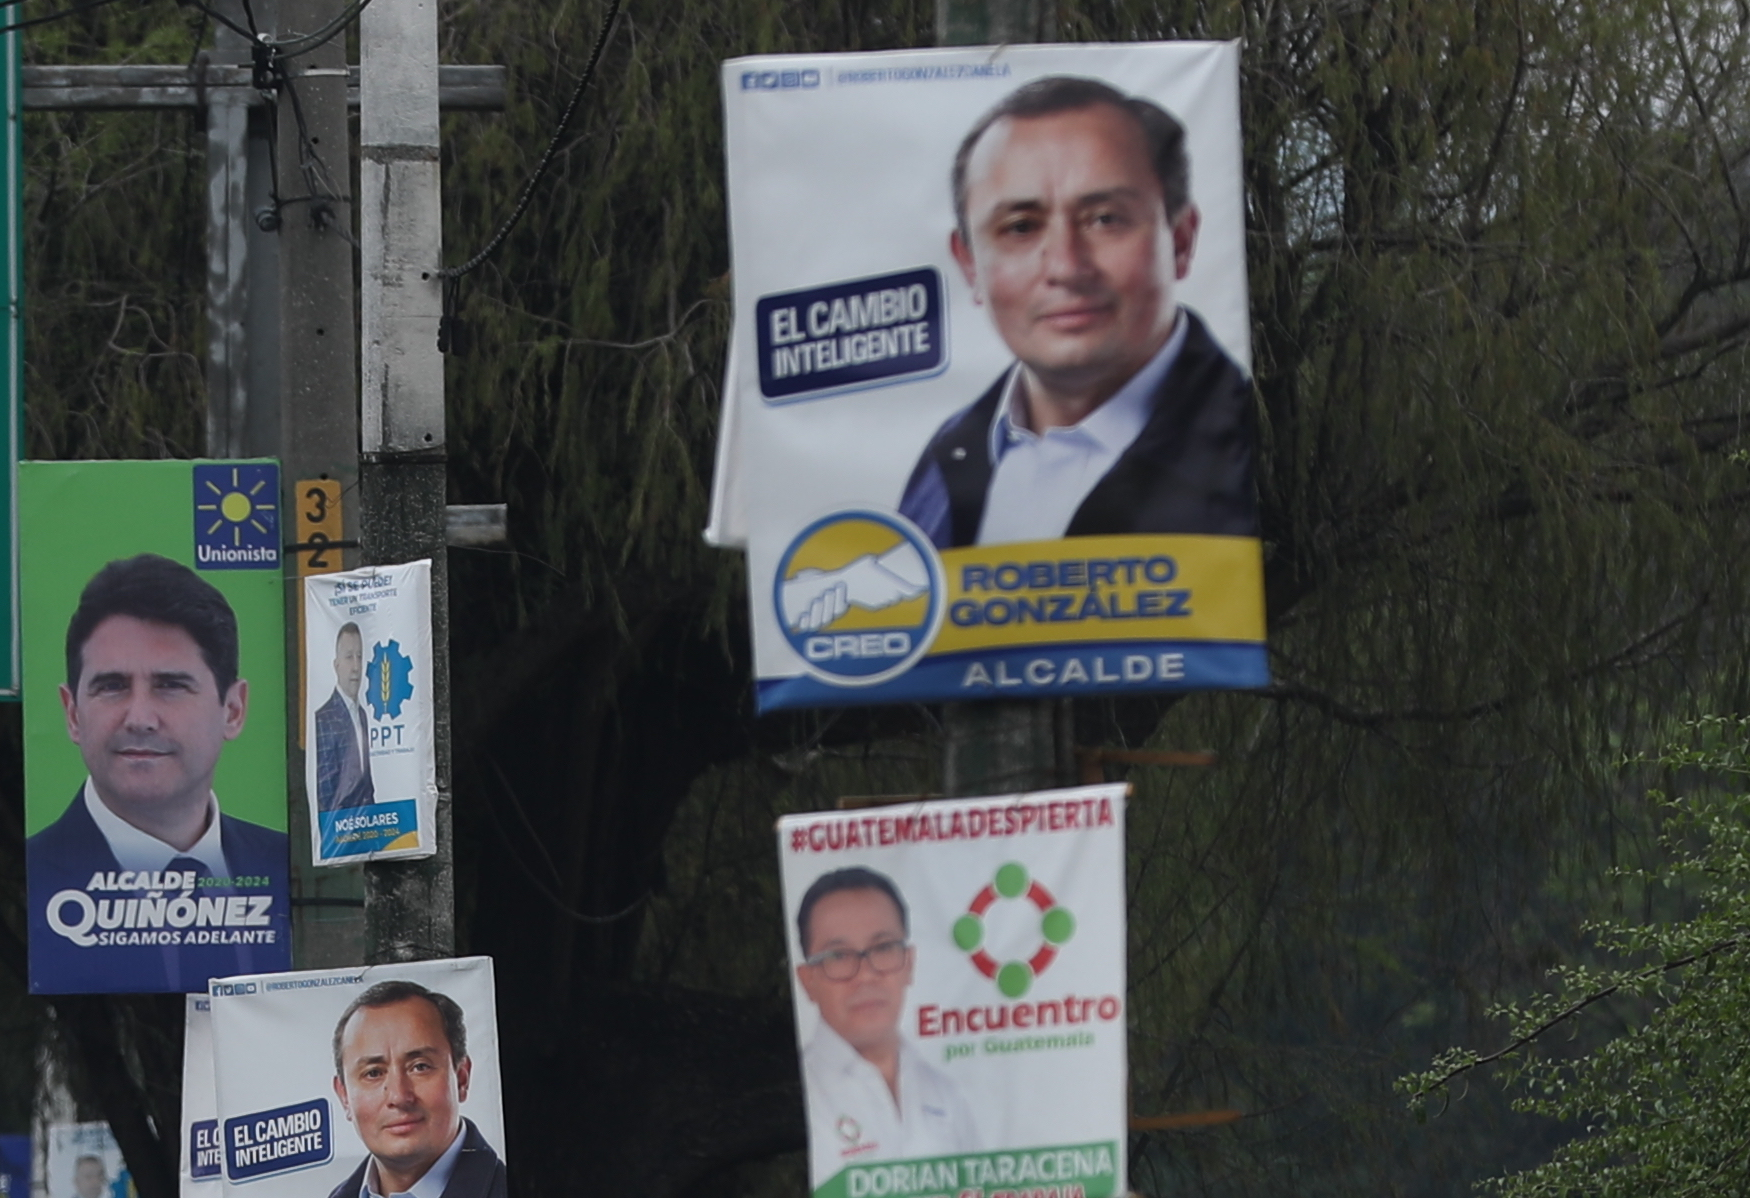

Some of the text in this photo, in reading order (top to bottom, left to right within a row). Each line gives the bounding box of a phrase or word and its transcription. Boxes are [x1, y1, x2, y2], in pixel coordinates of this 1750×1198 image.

[769, 282, 927, 345] EL CAMBIO
[770, 321, 931, 380] INTELIGENTE
[198, 544, 277, 563] Unionista
[961, 555, 1178, 593] ROBERTO
[949, 584, 1192, 627] GONZÁLEZ
[961, 653, 1185, 687] ALCALDE
[370, 723, 405, 749] PPT
[354, 812, 399, 829] SOLARES
[790, 797, 1116, 854] #GUATEMALADESPIERTA
[86, 870, 196, 891] ALCALDE
[98, 929, 276, 946] SIGAMOS ADELANTE
[917, 994, 1122, 1038] Encuentro
[983, 1030, 1095, 1056] Guatemala
[233, 1108, 321, 1148] EL CAMBIO
[235, 1131, 323, 1168] INTELIGENTE
[963, 1145, 1115, 1190] TARACENA
